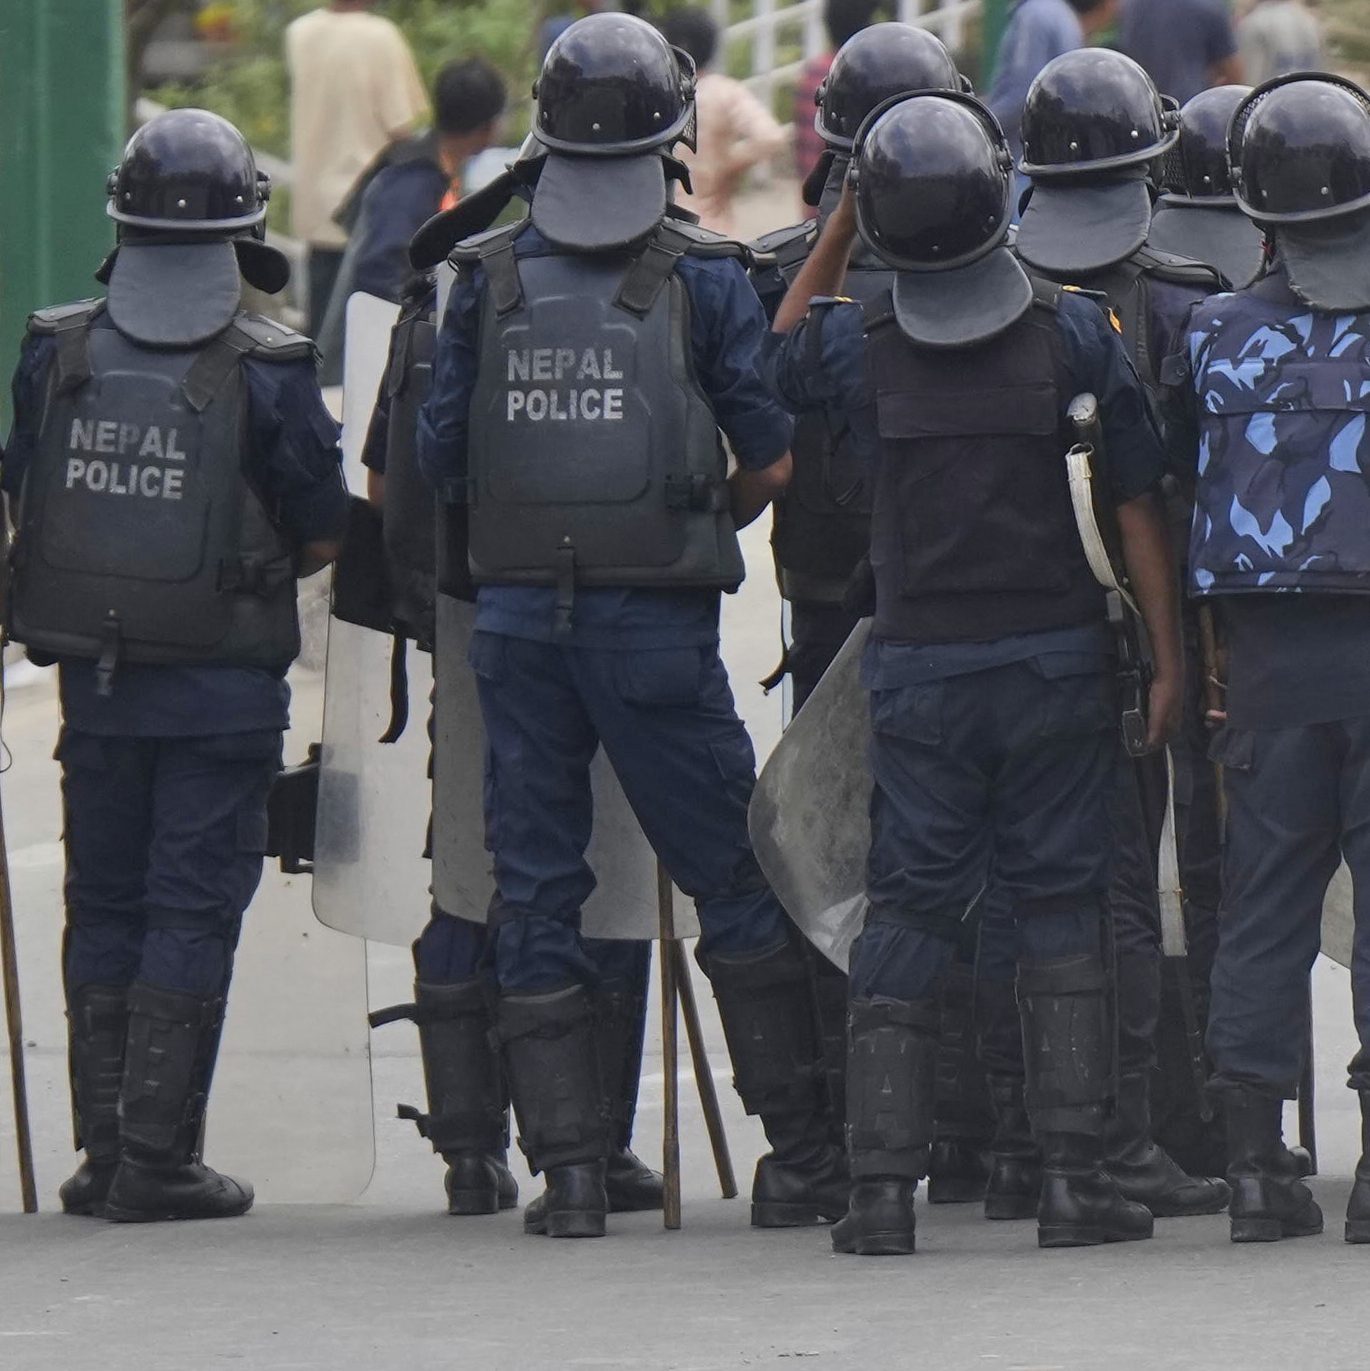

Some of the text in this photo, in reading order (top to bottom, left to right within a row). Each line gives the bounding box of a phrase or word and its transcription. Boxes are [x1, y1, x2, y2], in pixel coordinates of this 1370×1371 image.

[507, 348, 623, 381] NEPAL
[507, 388, 623, 421] POLICE
[70, 418, 186, 460] NEPAL
[65, 457, 184, 500] POLICE
